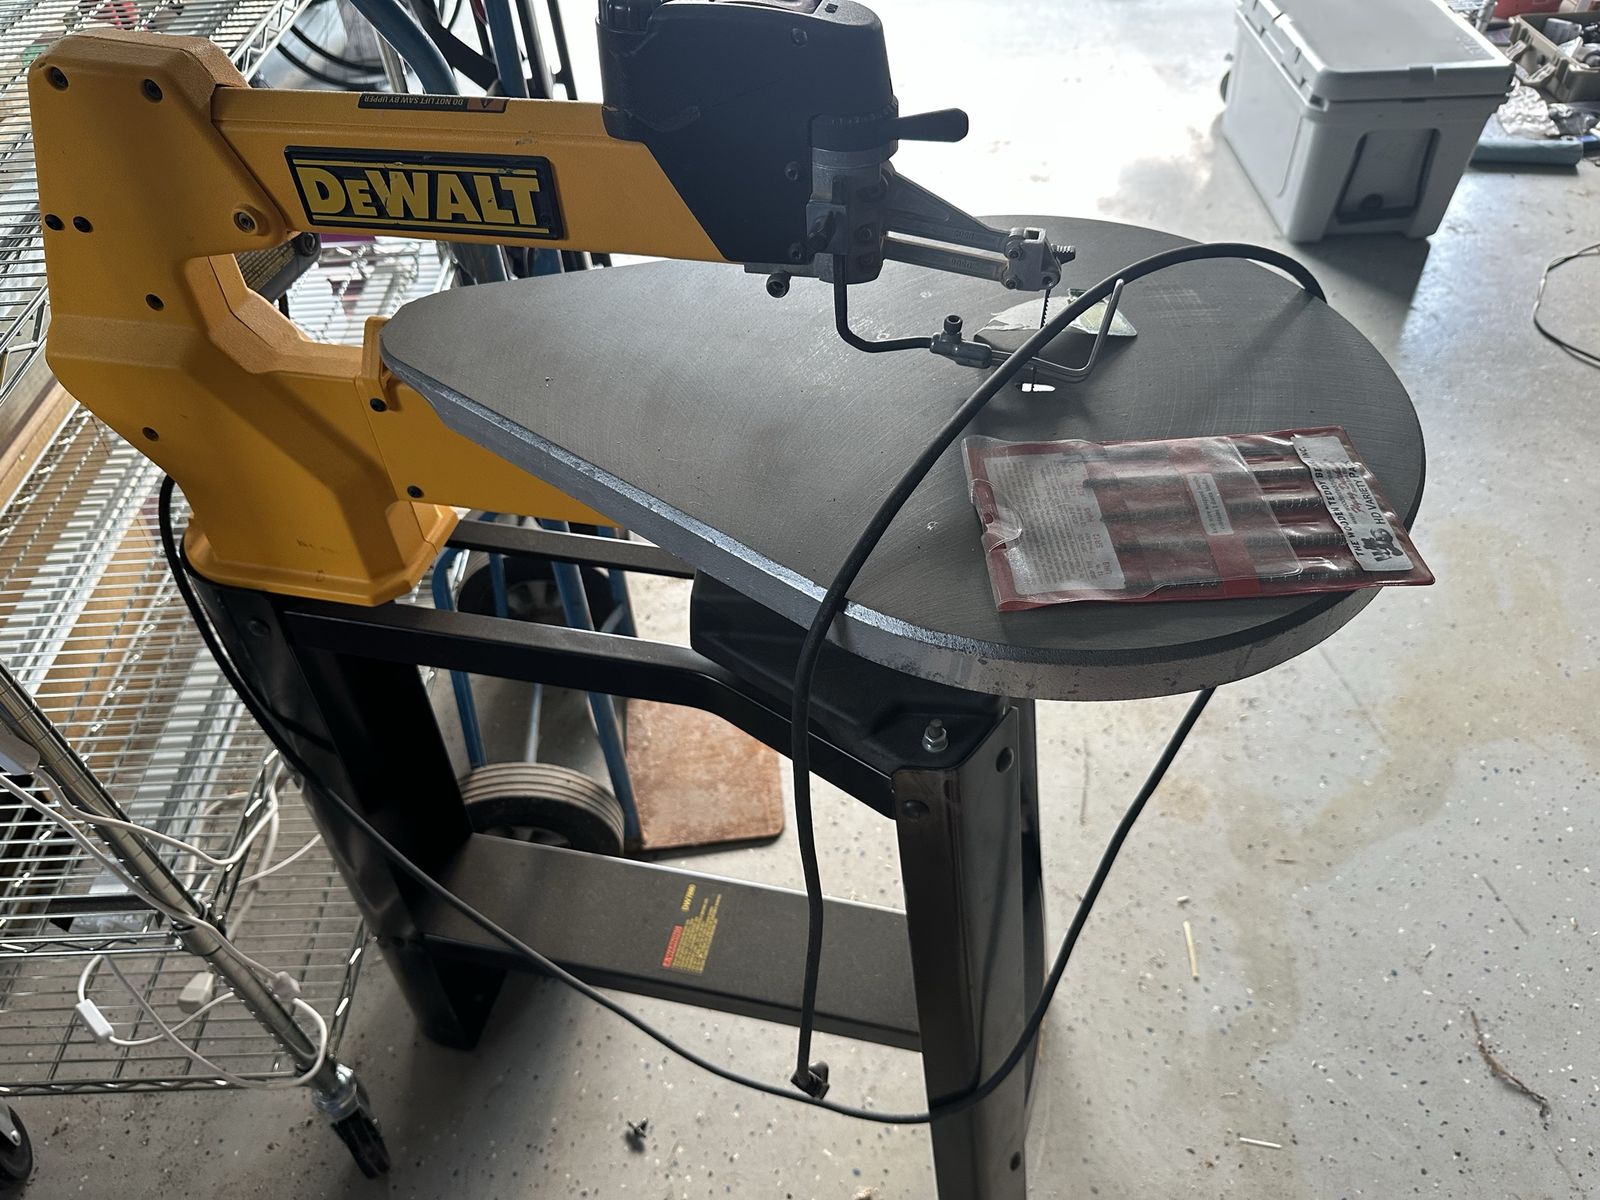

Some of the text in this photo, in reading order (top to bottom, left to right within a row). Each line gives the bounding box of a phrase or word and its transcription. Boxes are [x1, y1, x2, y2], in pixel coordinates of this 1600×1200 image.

[364, 95, 388, 103] UPPER
[388, 96, 400, 104] BY
[400, 96, 420, 104] SAW
[420, 97, 436, 105] LIFT
[452, 98, 464, 106] DO
[295, 166, 540, 226] DEWALT
[1318, 480, 1337, 506] TEDDY
[1330, 506, 1356, 539] WOODEN
[1370, 512, 1386, 525] HD
[1352, 540, 1365, 557] THE
